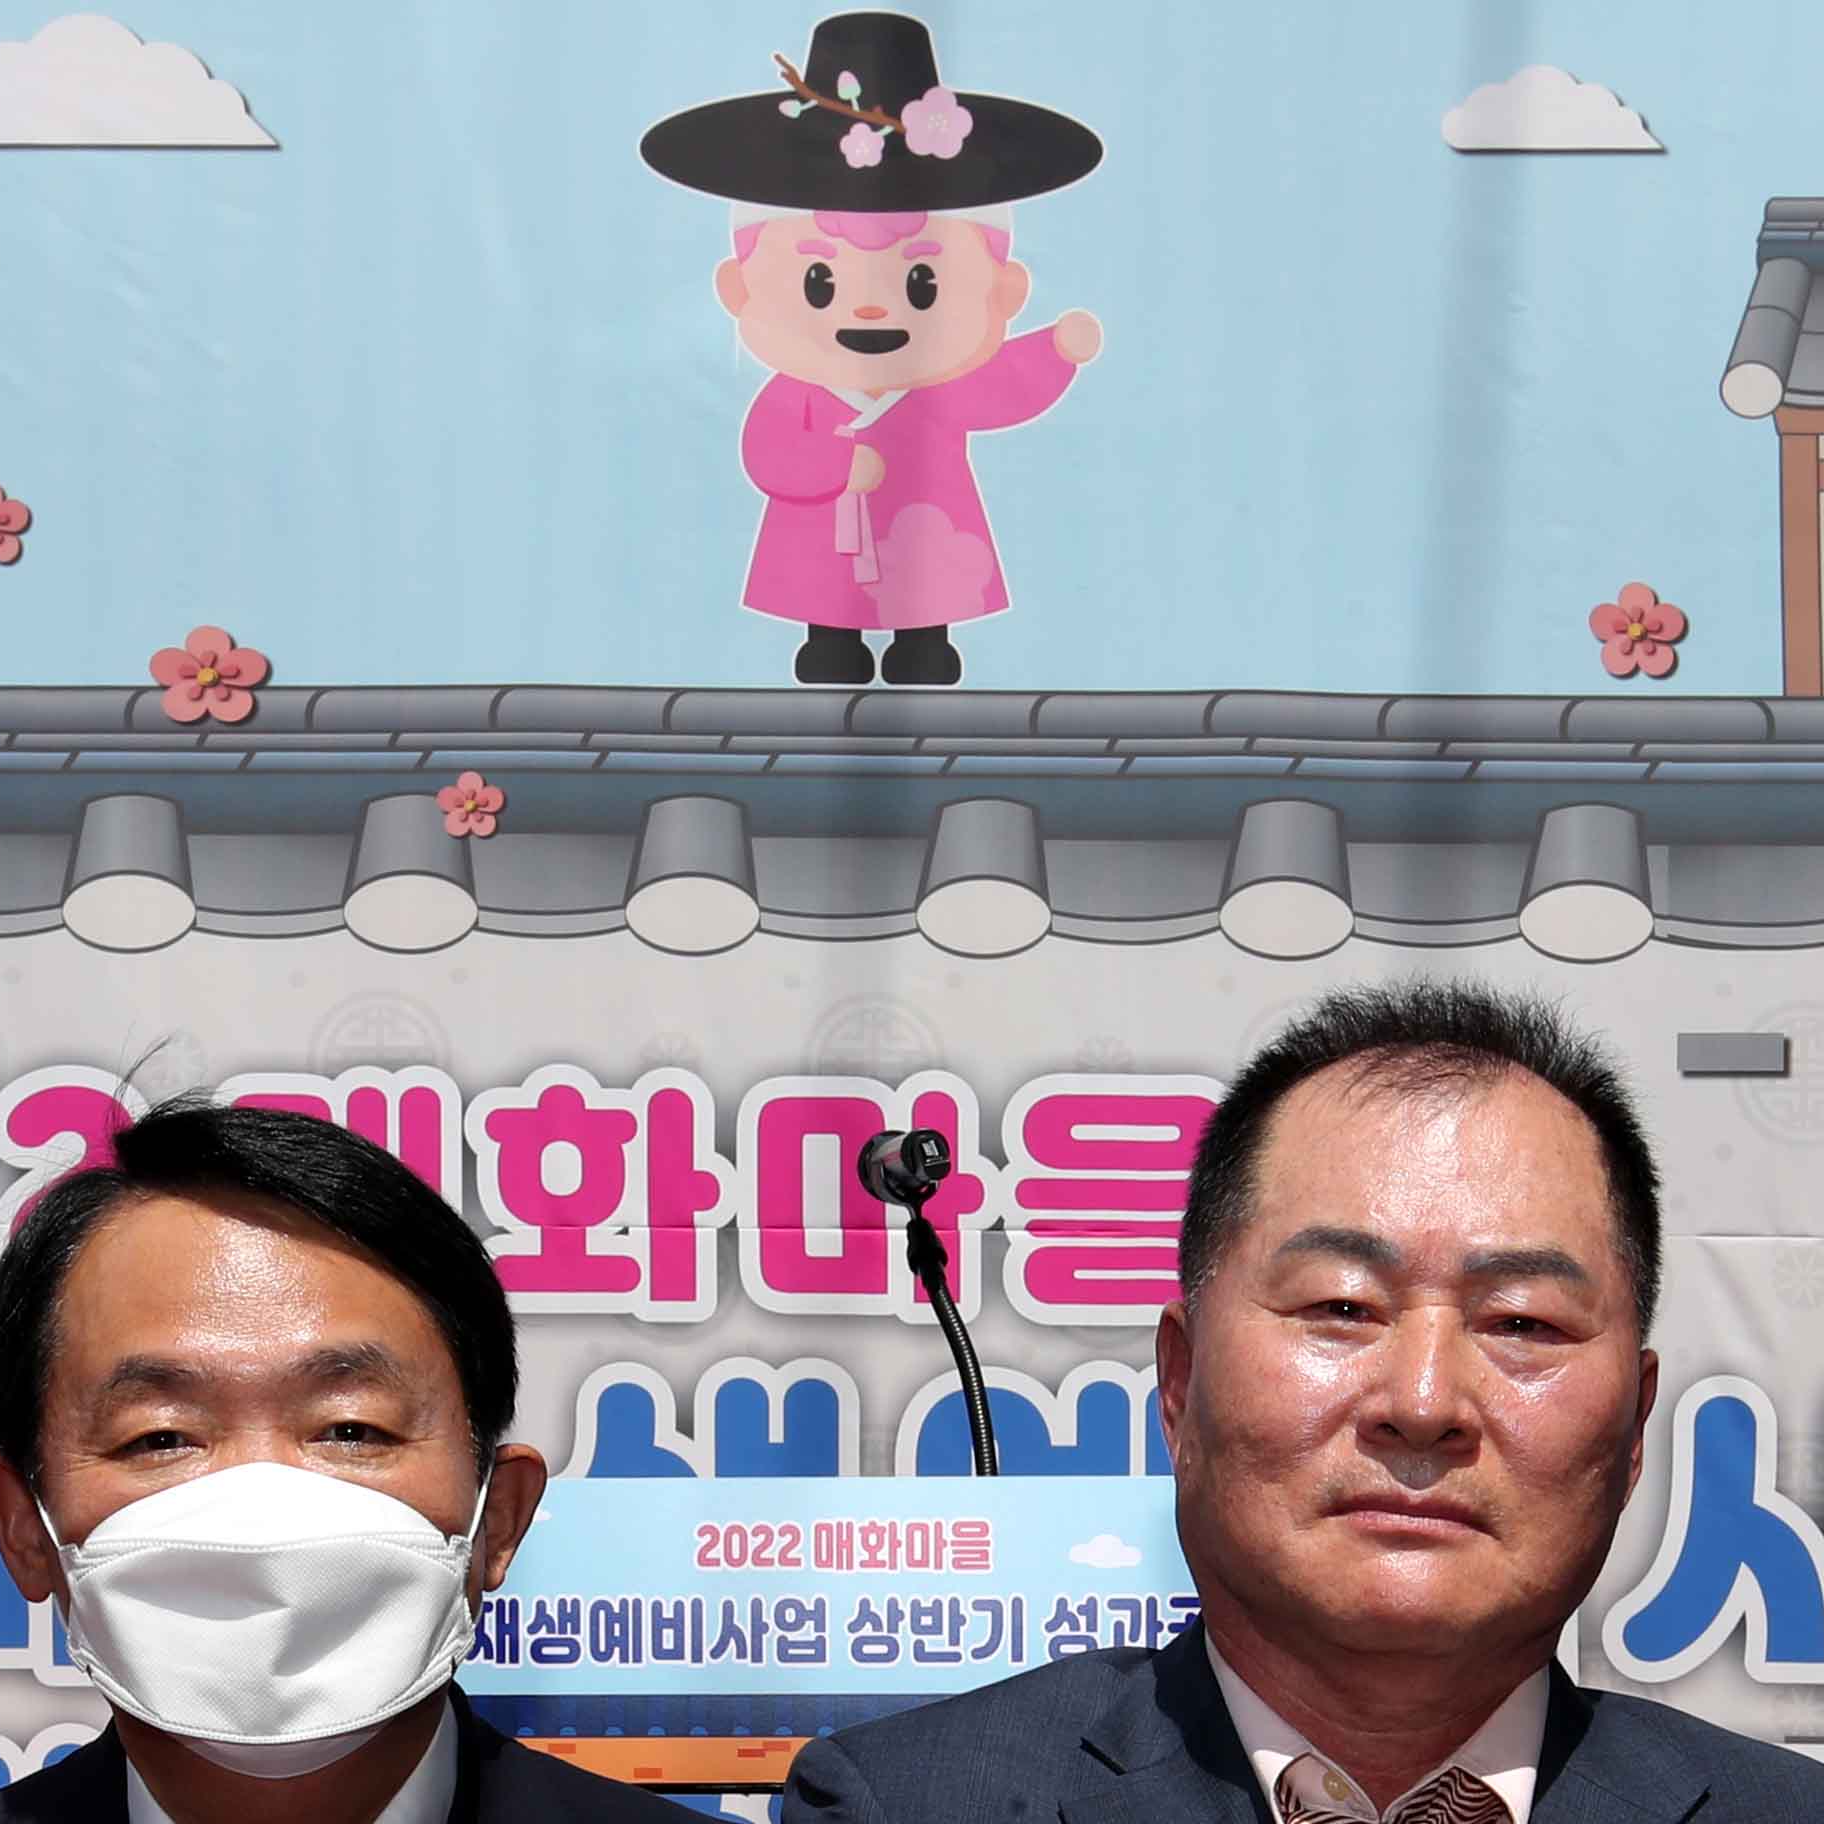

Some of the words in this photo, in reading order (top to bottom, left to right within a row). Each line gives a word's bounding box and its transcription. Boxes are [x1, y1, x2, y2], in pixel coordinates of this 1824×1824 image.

[696, 1522, 804, 1570] 2022
[813, 1519, 994, 1573] 매화마을
[846, 1594, 1025, 1667] 상반기
